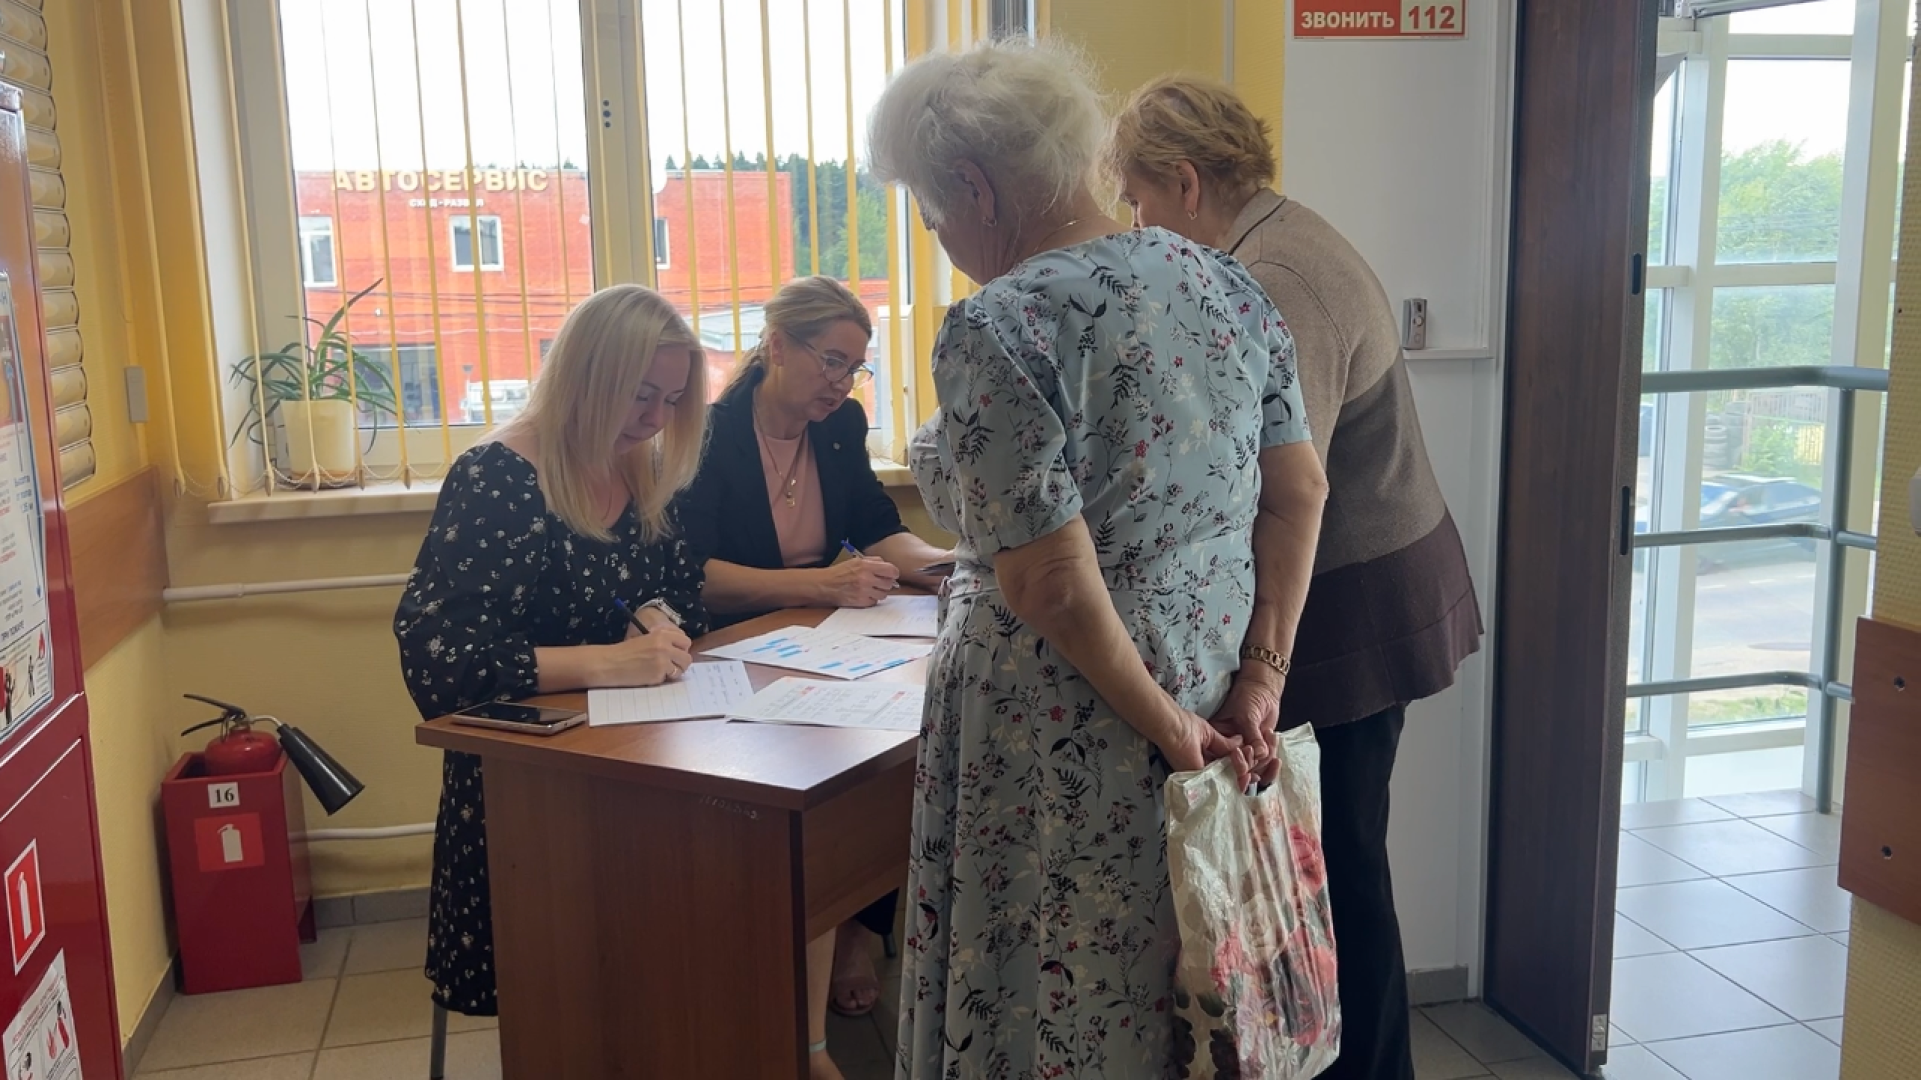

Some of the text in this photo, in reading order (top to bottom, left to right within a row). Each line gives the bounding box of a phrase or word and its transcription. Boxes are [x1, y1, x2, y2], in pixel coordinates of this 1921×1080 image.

[1301, 5, 1455, 30] ЗВОНИТЬ 112
[332, 169, 549, 191] АВТОСЕРВИС
[214, 788, 234, 803] 16
